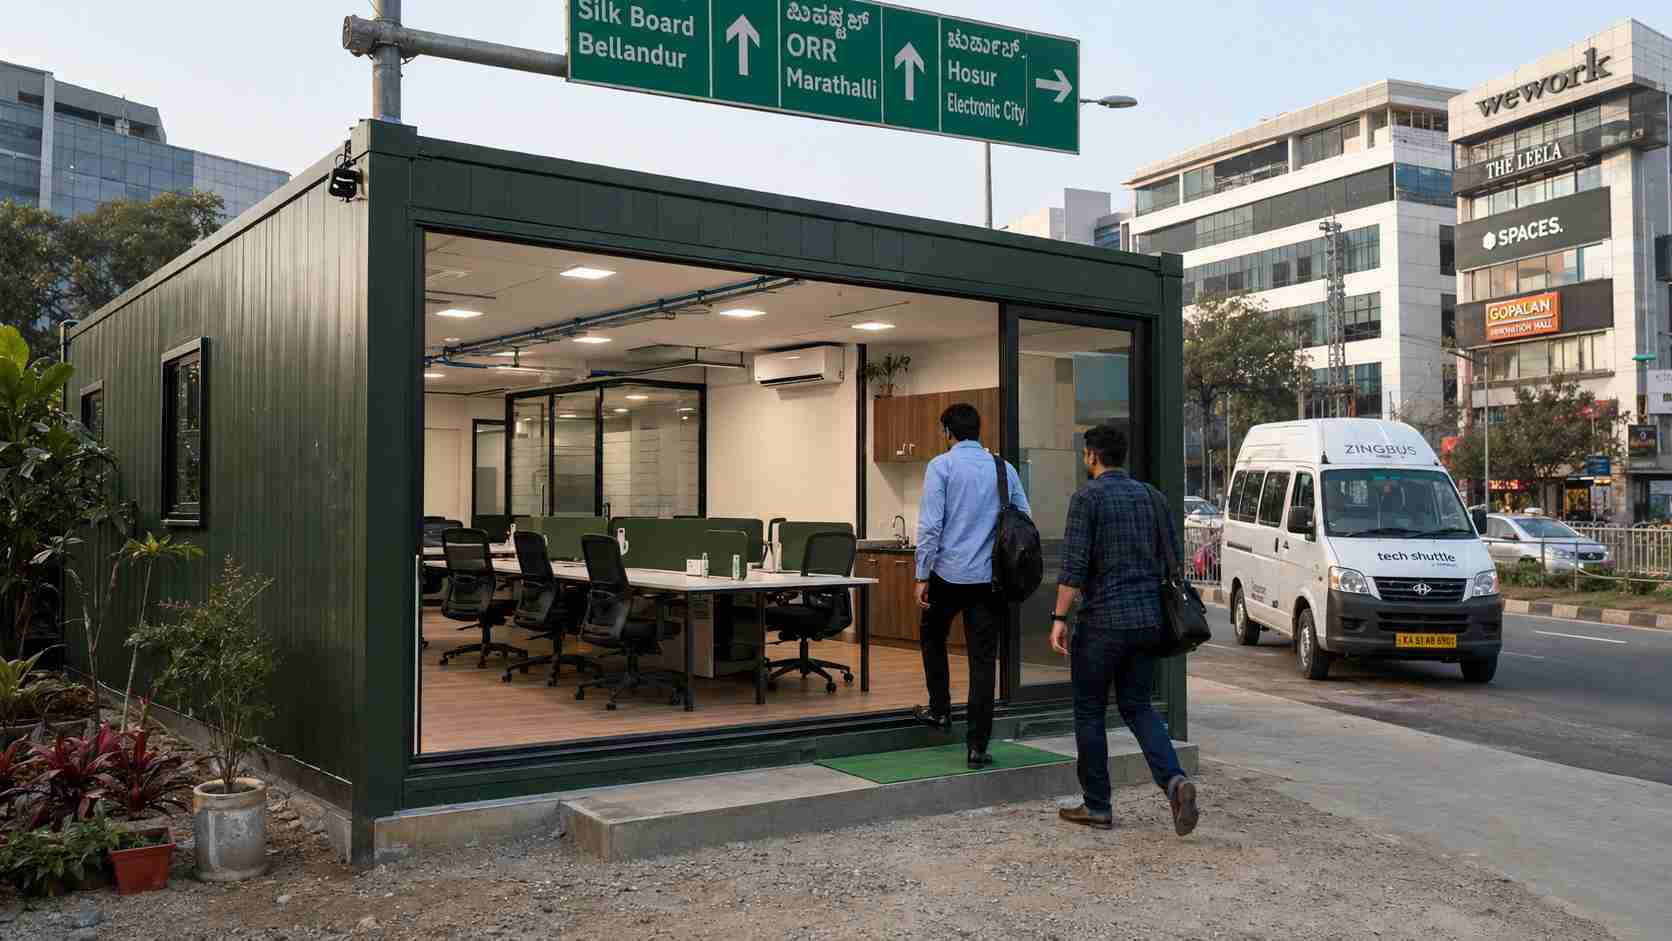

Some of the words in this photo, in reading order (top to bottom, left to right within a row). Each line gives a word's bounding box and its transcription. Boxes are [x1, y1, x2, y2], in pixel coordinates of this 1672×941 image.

[578, 0, 622, 25] Silk
[630, 5, 694, 36] Board
[578, 31, 687, 68] Bellandur
[787, 33, 837, 62] ORR
[786, 66, 877, 99] Marathalli
[947, 59, 997, 87] Hosur
[1475, 47, 1613, 117] wework
[947, 92, 1001, 119] Electronic
[1003, 101, 1025, 126] City
[1486, 157, 1514, 179] THE
[1518, 143, 1562, 170] LEELA
[1498, 216, 1564, 246] SPACES.
[1489, 298, 1551, 321] GOPALAN
[1344, 444, 1417, 456] ZINGBUS
[1377, 551, 1408, 561] tech
[1411, 551, 1456, 562] shuttle
